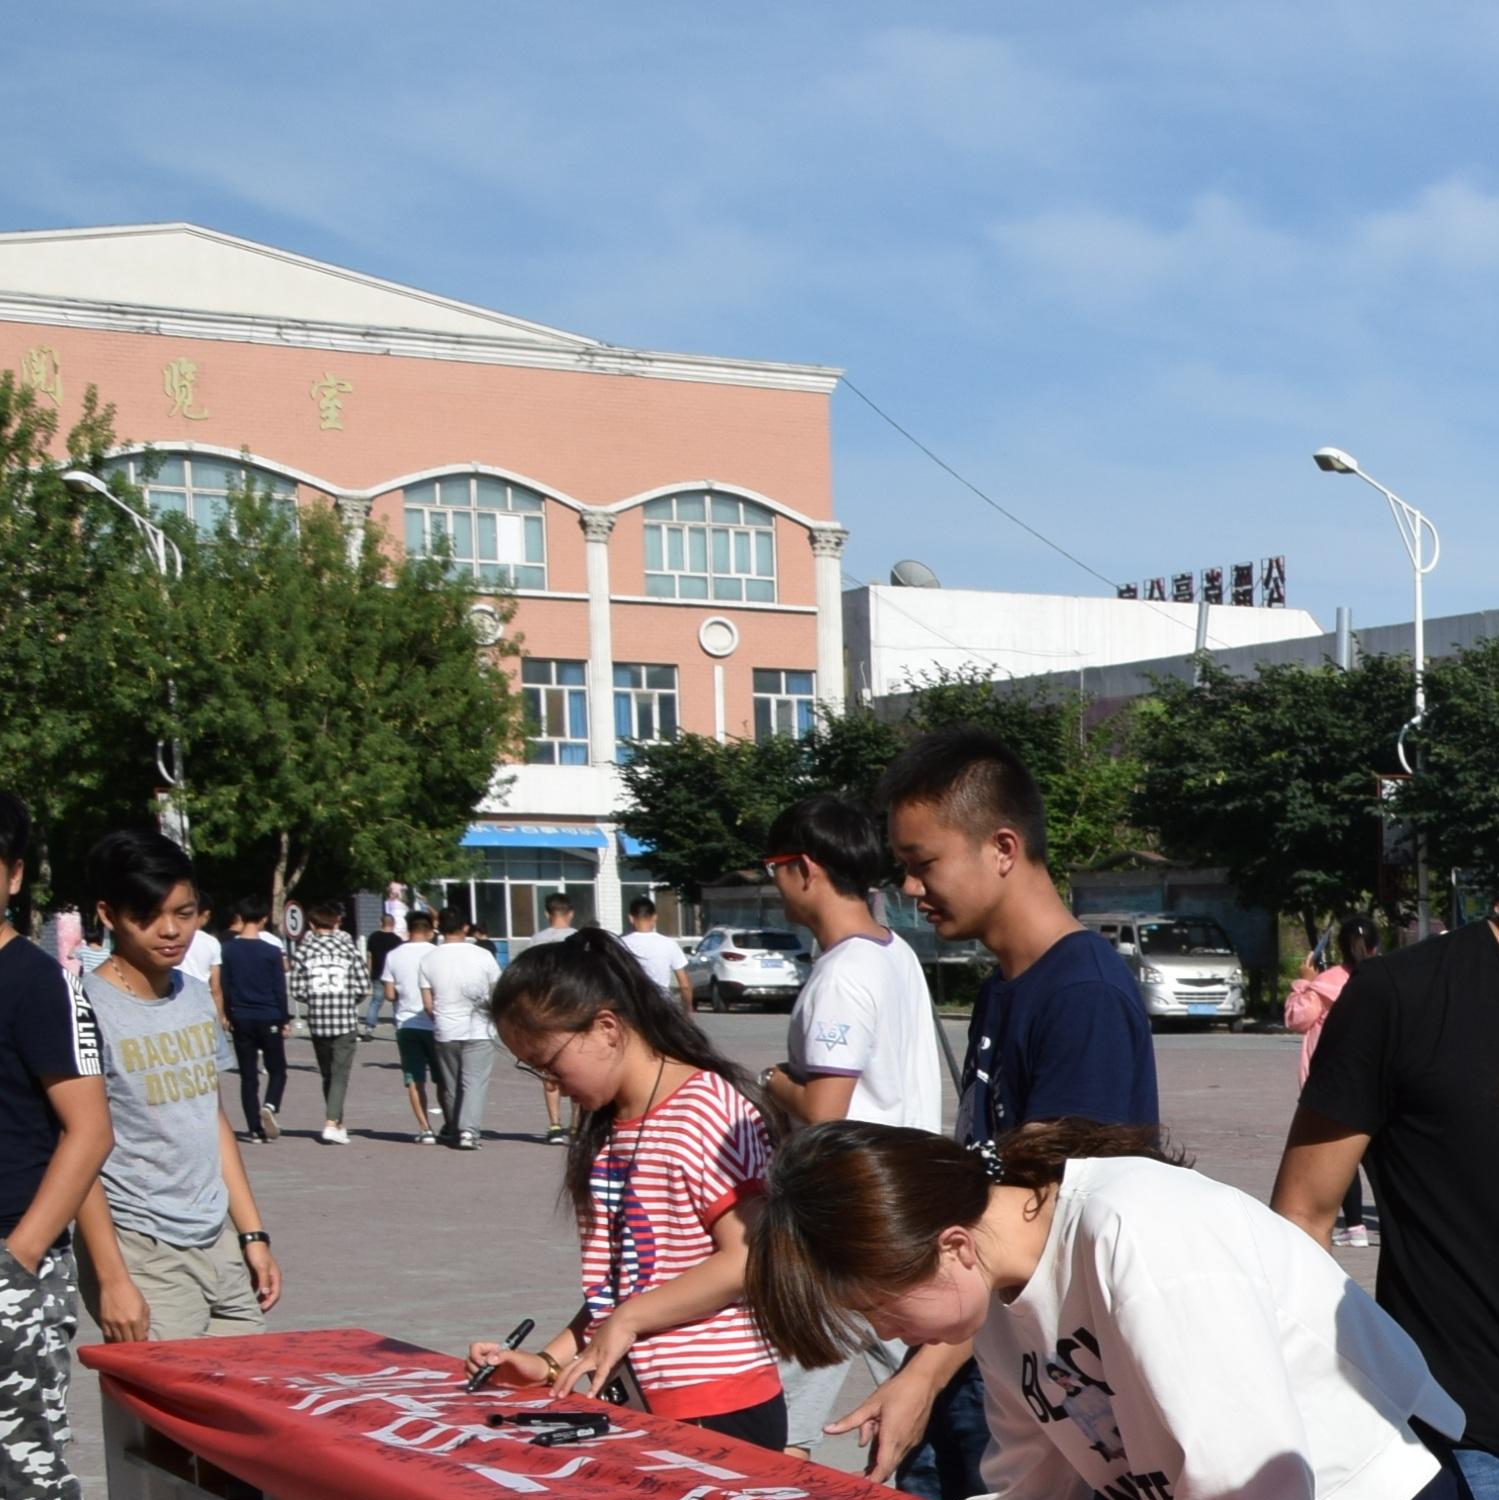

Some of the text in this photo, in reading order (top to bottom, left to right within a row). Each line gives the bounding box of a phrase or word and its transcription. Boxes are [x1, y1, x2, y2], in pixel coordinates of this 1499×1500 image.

[289, 908, 299, 931] 5
[311, 967, 345, 993] 23
[78, 1021, 100, 1059] LIFE
